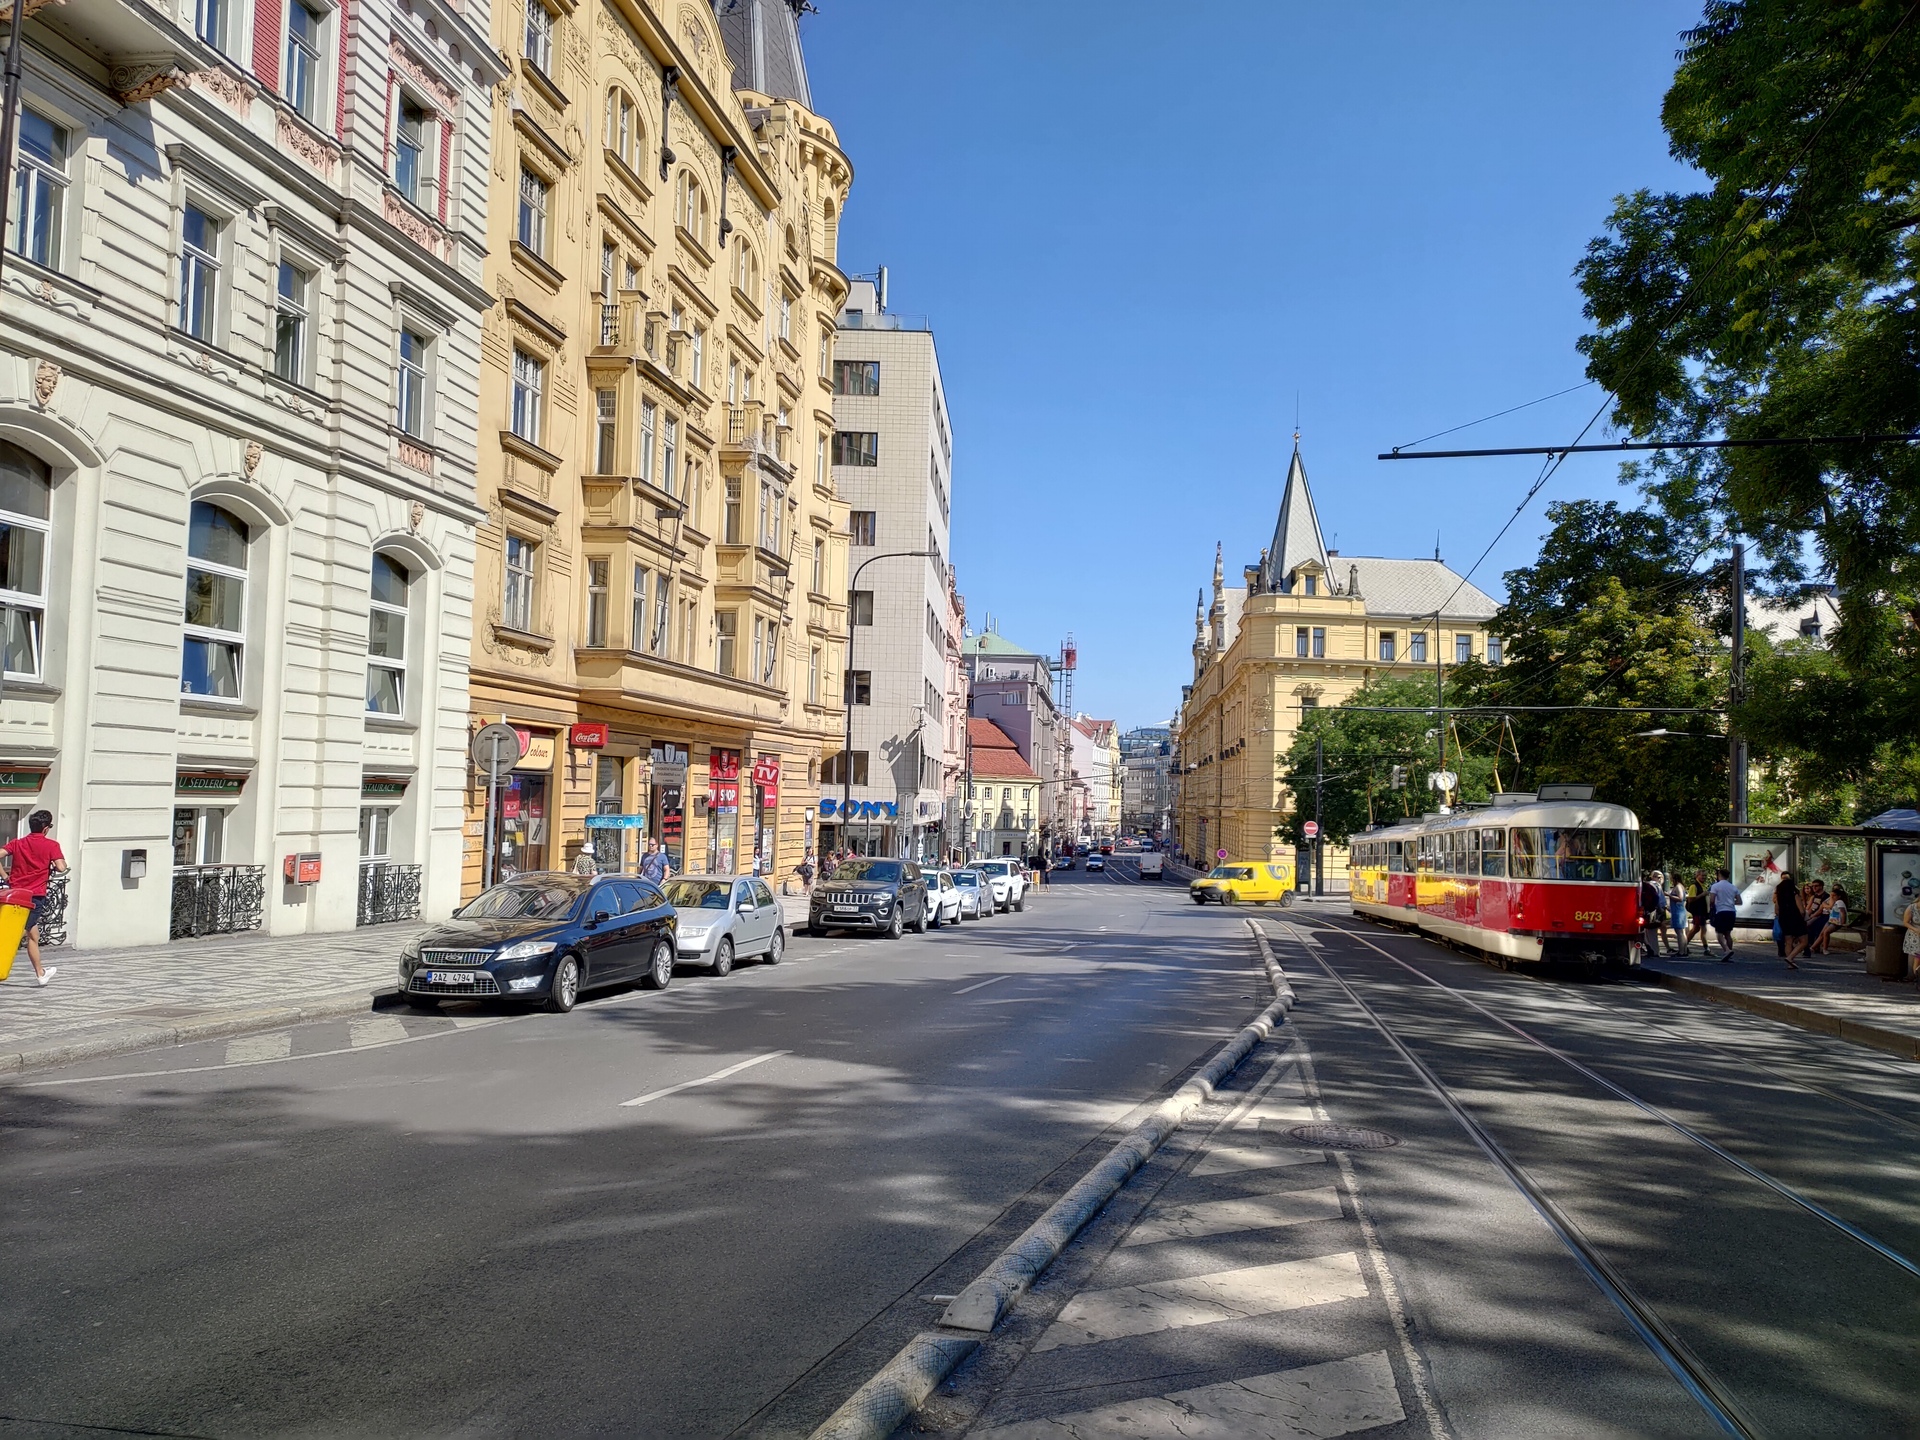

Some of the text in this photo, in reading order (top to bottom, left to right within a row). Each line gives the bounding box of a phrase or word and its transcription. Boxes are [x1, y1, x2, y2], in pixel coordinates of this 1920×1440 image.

[756, 765, 778, 781] TV
[178, 777, 188, 788] U
[720, 789, 736, 801] SHOP
[819, 798, 899, 818] SONY
[1577, 864, 1596, 878] 14
[1574, 910, 1603, 922] 8473
[433, 973, 471, 982] 2AZ 4794
